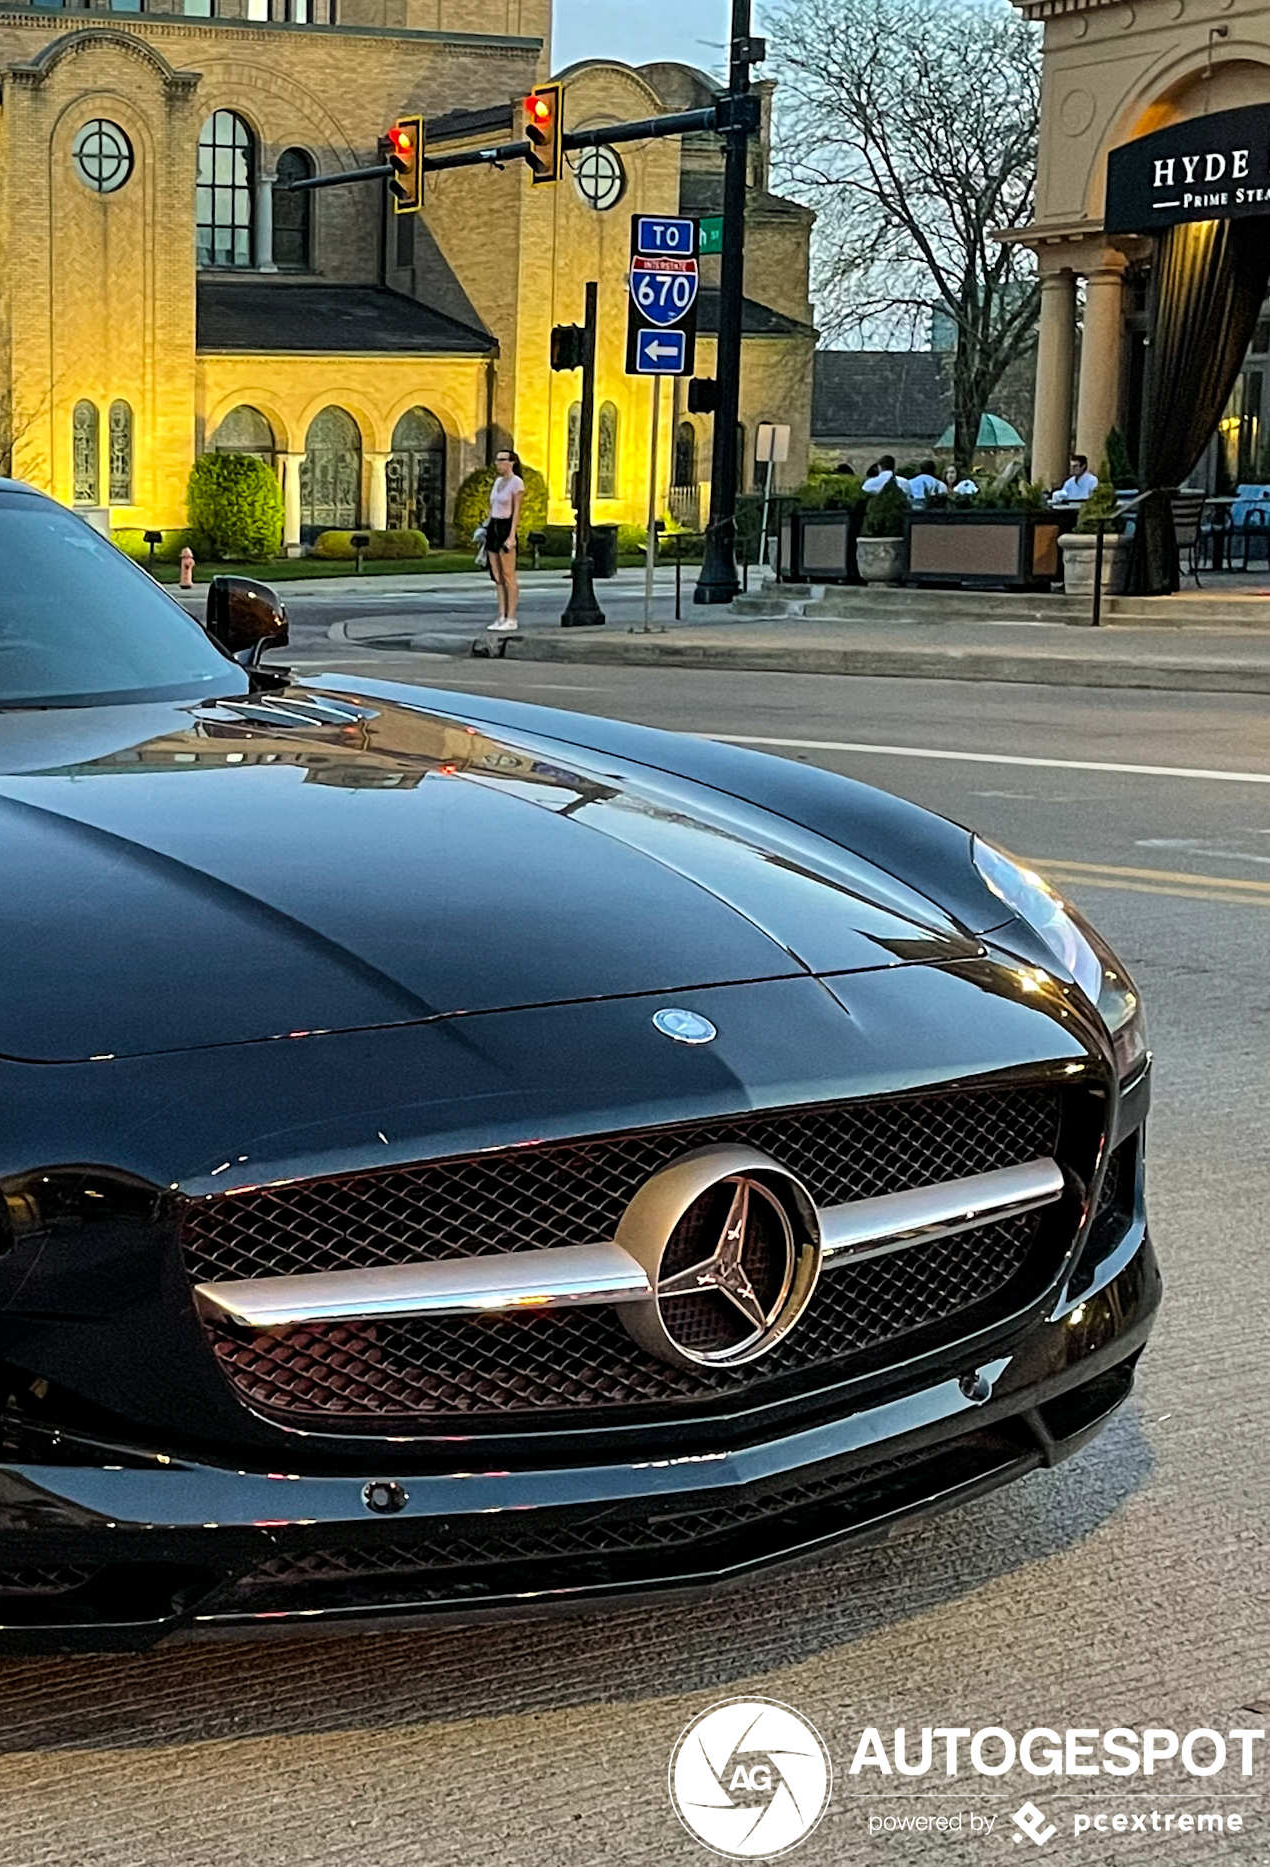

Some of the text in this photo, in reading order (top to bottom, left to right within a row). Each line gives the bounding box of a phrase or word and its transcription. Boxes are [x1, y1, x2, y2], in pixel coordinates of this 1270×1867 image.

[1153, 149, 1249, 187] HYDE
[1183, 192, 1228, 208] PRIME
[653, 225, 679, 247] TO
[638, 275, 690, 307] 670
